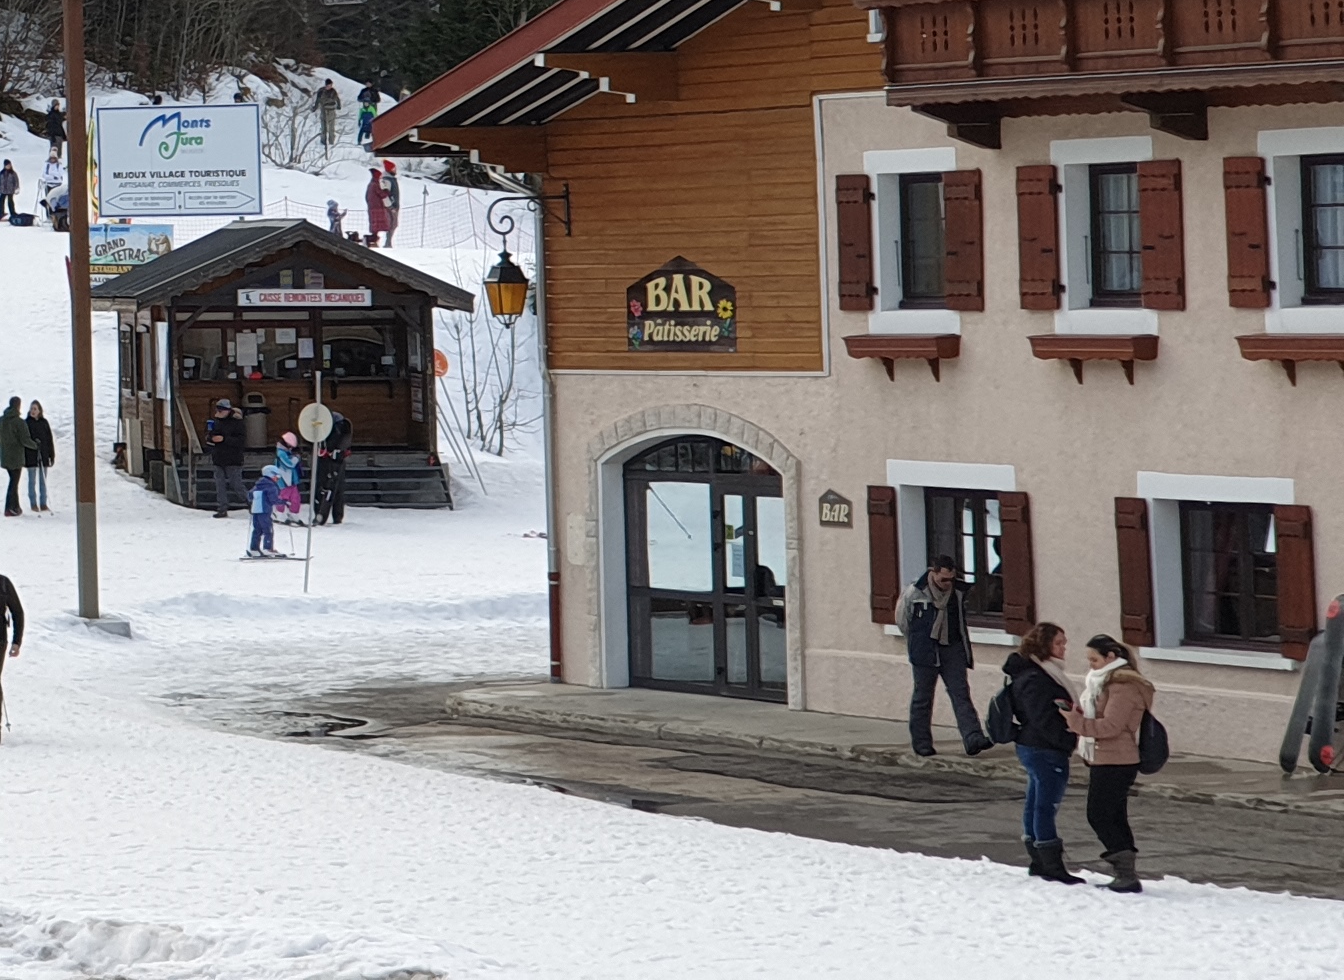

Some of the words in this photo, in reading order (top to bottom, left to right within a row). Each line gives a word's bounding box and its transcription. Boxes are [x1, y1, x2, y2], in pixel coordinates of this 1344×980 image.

[139, 111, 212, 147] Monts
[159, 131, 204, 160] Jura
[113, 171, 147, 179] MIJOUX
[149, 170, 186, 179] VILLAGE
[188, 169, 247, 178] TOURISTIQUE
[95, 237, 126, 257] GRAND
[110, 247, 147, 263] TETRAS
[645, 273, 715, 312] BAR
[643, 319, 720, 342] Pâtisserie
[821, 502, 849, 523] BAR
